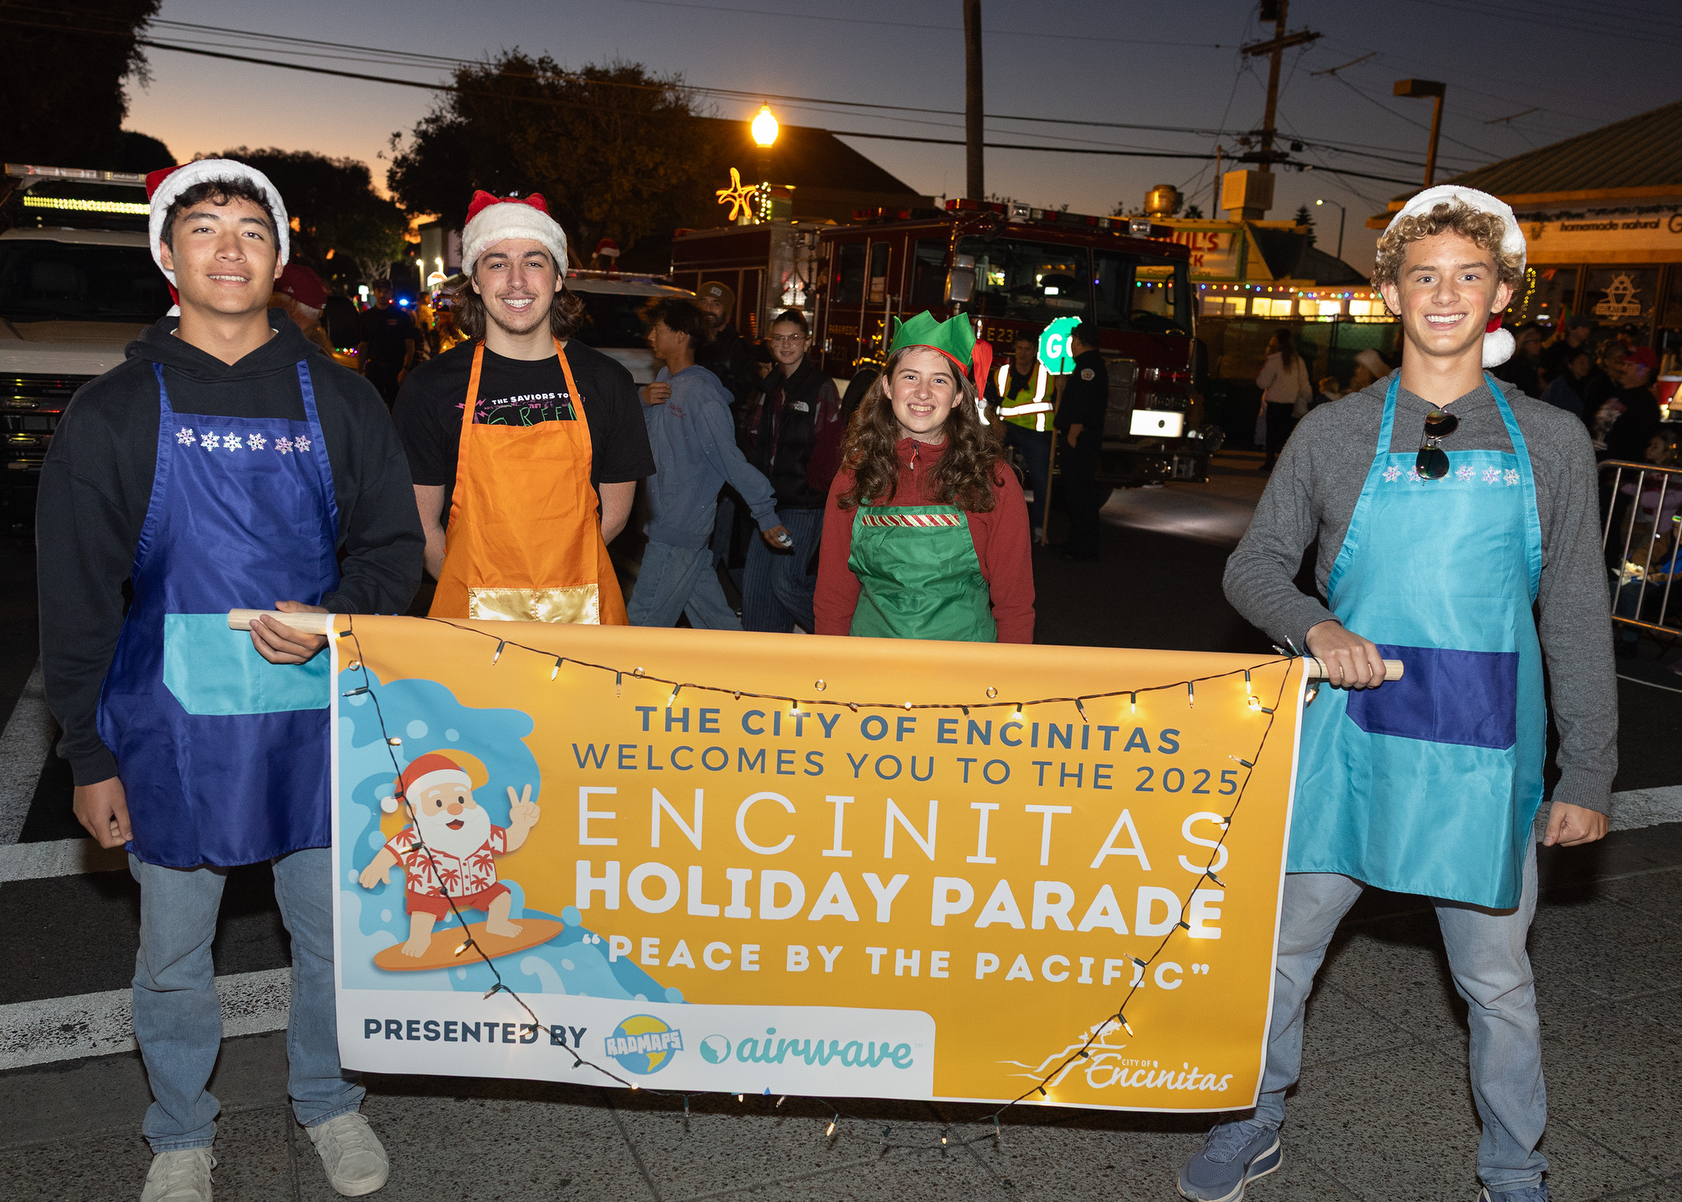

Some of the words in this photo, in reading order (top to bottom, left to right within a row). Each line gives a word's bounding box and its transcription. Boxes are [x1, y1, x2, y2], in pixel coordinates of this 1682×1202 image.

[1560, 220, 1618, 231] homemade
[1622, 218, 1660, 229] natural
[510, 393, 556, 403] SAVIORS
[635, 706, 720, 734] THE
[741, 709, 841, 738] CITY
[860, 715, 917, 742] OF
[937, 718, 1180, 754] ENCINITAS
[572, 743, 823, 777] WELCOMES
[847, 752, 935, 782] YOU
[957, 757, 1011, 785] TO
[1032, 761, 1114, 790] THE
[1136, 766, 1239, 796] 2025
[578, 786, 1229, 875] ENCINITAS
[575, 859, 910, 923] HOLIDAY
[931, 876, 1225, 940] PARADE
[786, 944, 843, 973] BY
[865, 946, 951, 978] THE
[364, 1018, 539, 1045] PRESENTED
[549, 1024, 587, 1048] BY
[606, 1031, 681, 1056] RADMAPS
[736, 1027, 914, 1069] airwave
[1085, 1052, 1233, 1091] Encinitas
[1122, 1058, 1139, 1067] CITY
[1141, 1059, 1151, 1067] OF
